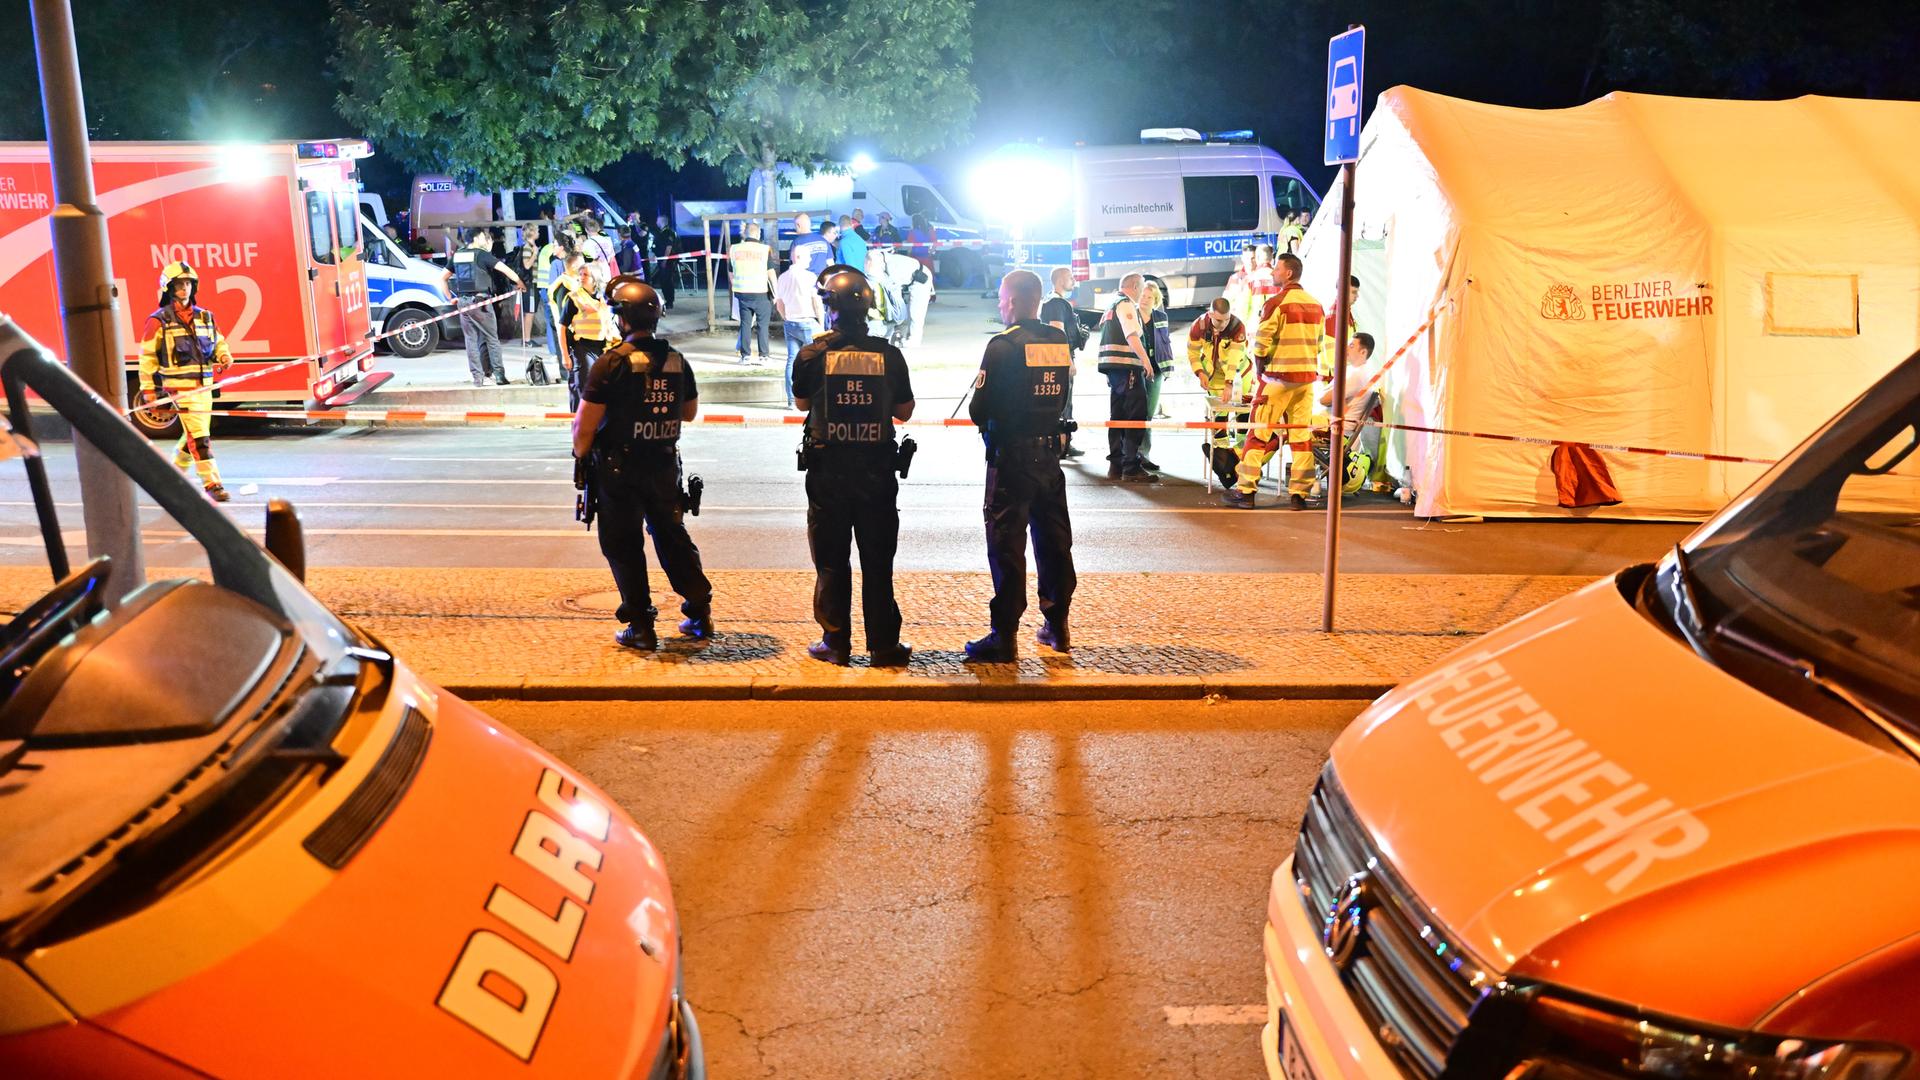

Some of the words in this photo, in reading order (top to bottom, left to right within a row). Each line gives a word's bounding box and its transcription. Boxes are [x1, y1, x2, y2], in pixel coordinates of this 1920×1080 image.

[419, 182, 452, 193] POLIZEI
[1102, 203, 1174, 214] Kriminaltechnik
[150, 243, 258, 268] NOTRUF
[345, 281, 363, 313] 112
[1592, 281, 1673, 300] BERLINER
[1592, 296, 1714, 320] FEUERWEHR
[1043, 371, 1056, 383] BE
[653, 380, 668, 390] BE
[846, 380, 863, 392] BE
[1033, 384, 1061, 395] 13319
[836, 393, 873, 405] 13313
[633, 421, 679, 440] POLIZEI
[827, 422, 881, 441] POLIZEI
[1405, 649, 1711, 895] FEUERWEHR
